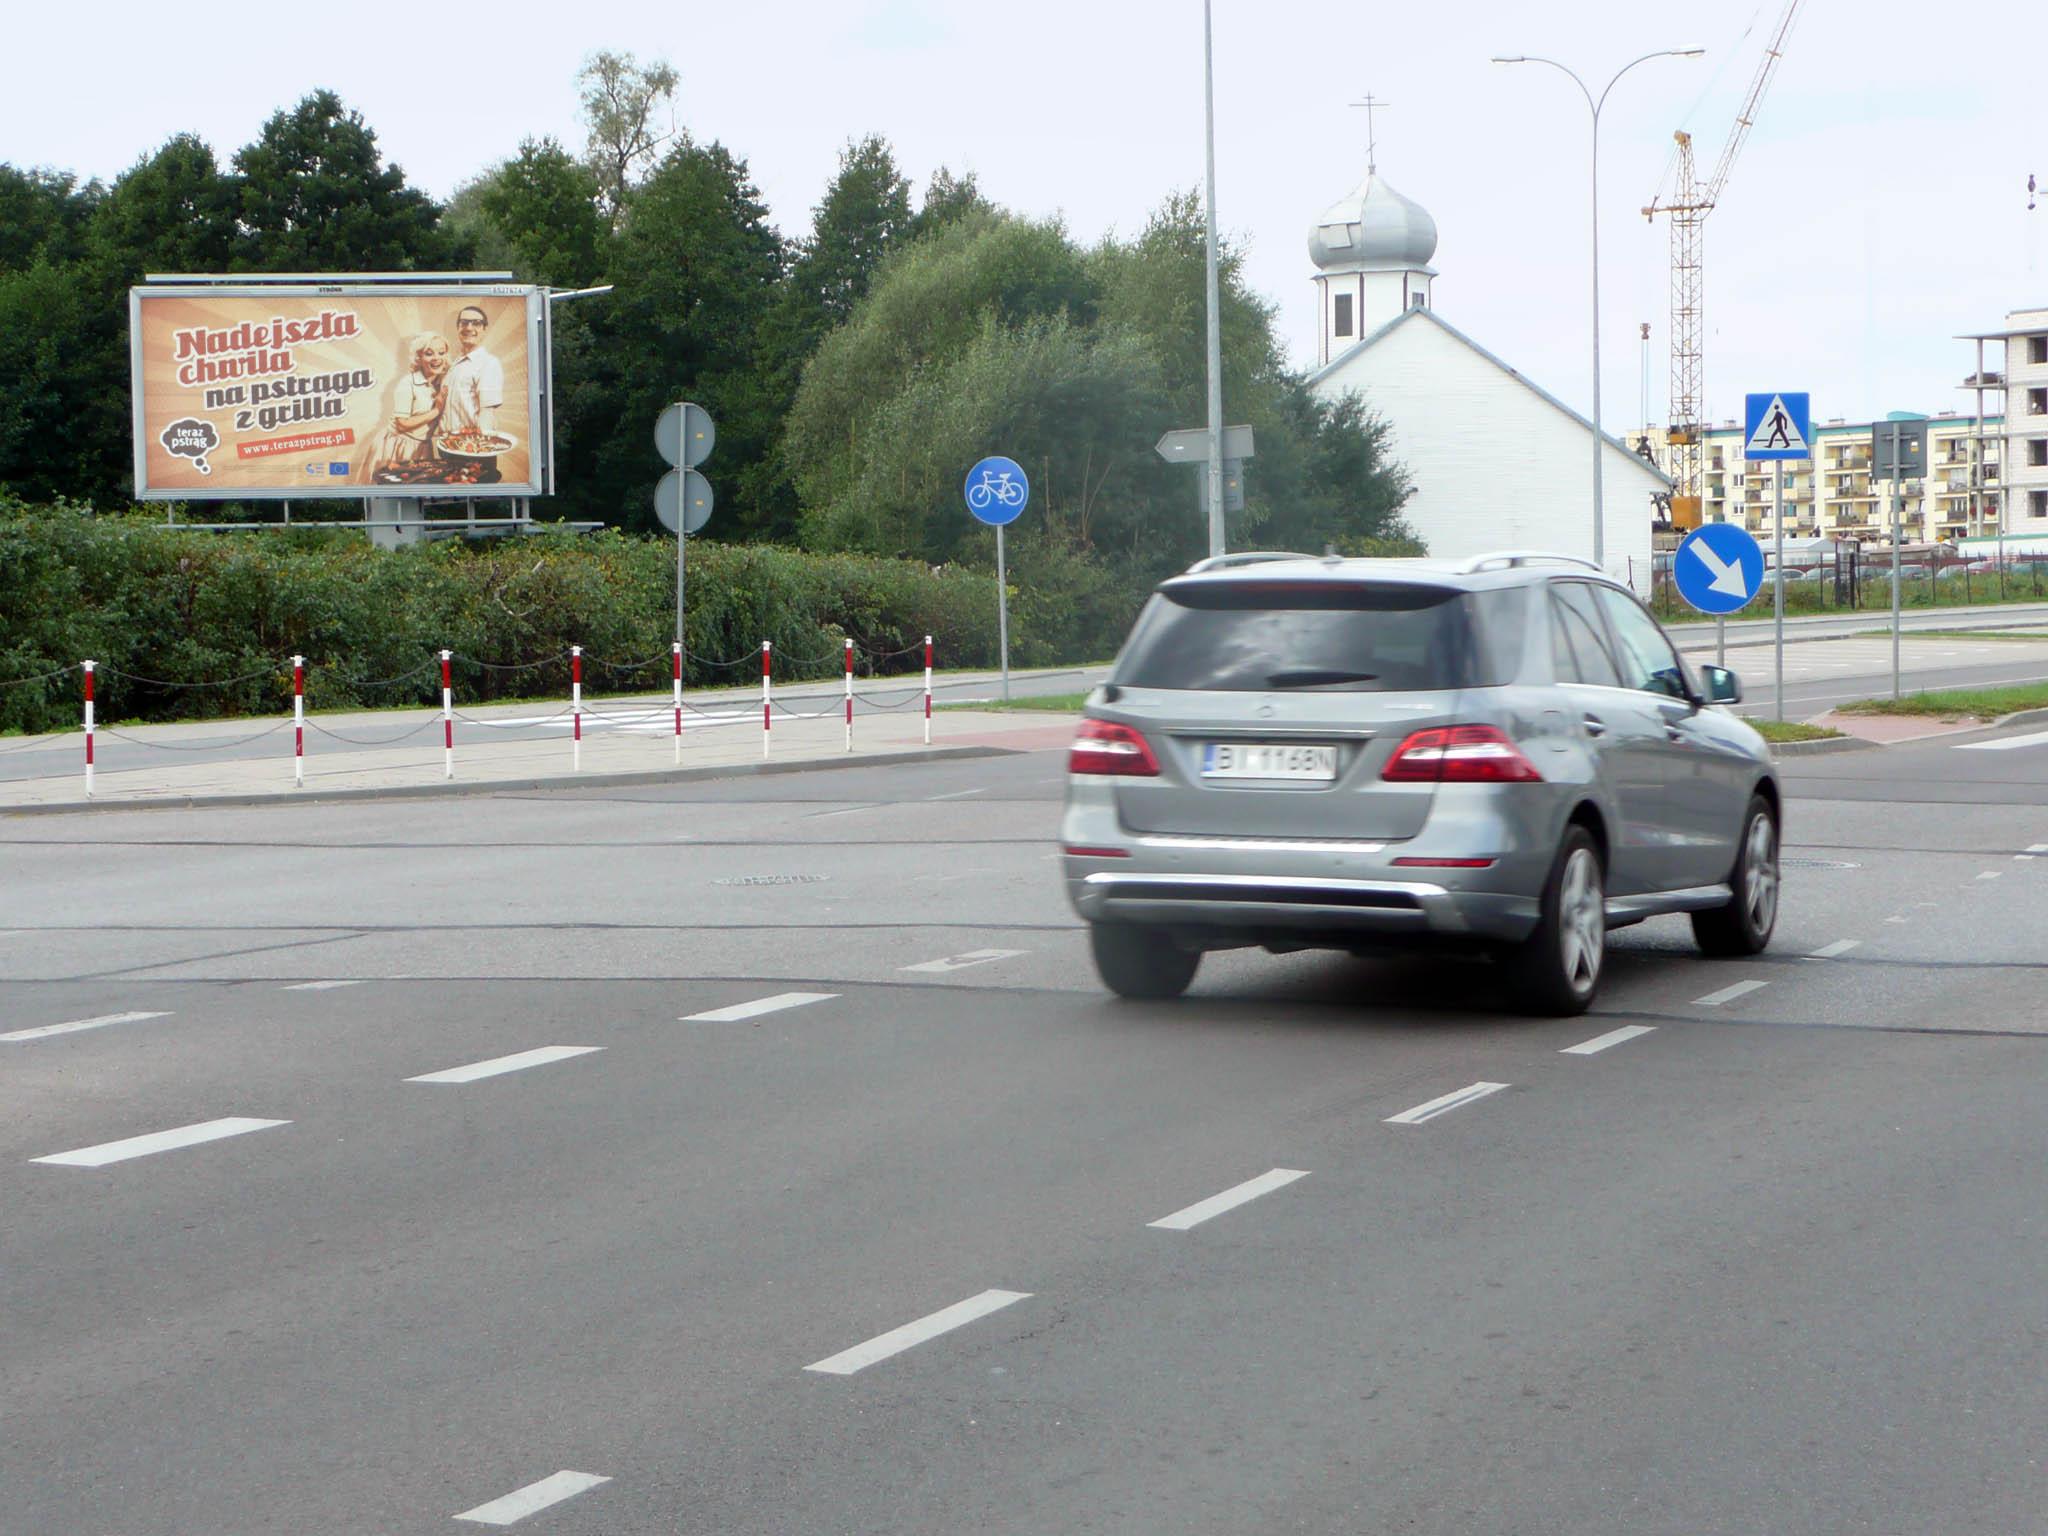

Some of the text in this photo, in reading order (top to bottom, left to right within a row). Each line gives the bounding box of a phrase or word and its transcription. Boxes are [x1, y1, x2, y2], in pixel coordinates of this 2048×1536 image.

[176, 312, 360, 359] Nadejszła
[179, 350, 294, 385] chwila
[206, 369, 373, 409] na pstrąga
[236, 397, 346, 429] z grilla
[171, 436, 208, 449] pstrąg
[177, 427, 204, 437] teraz
